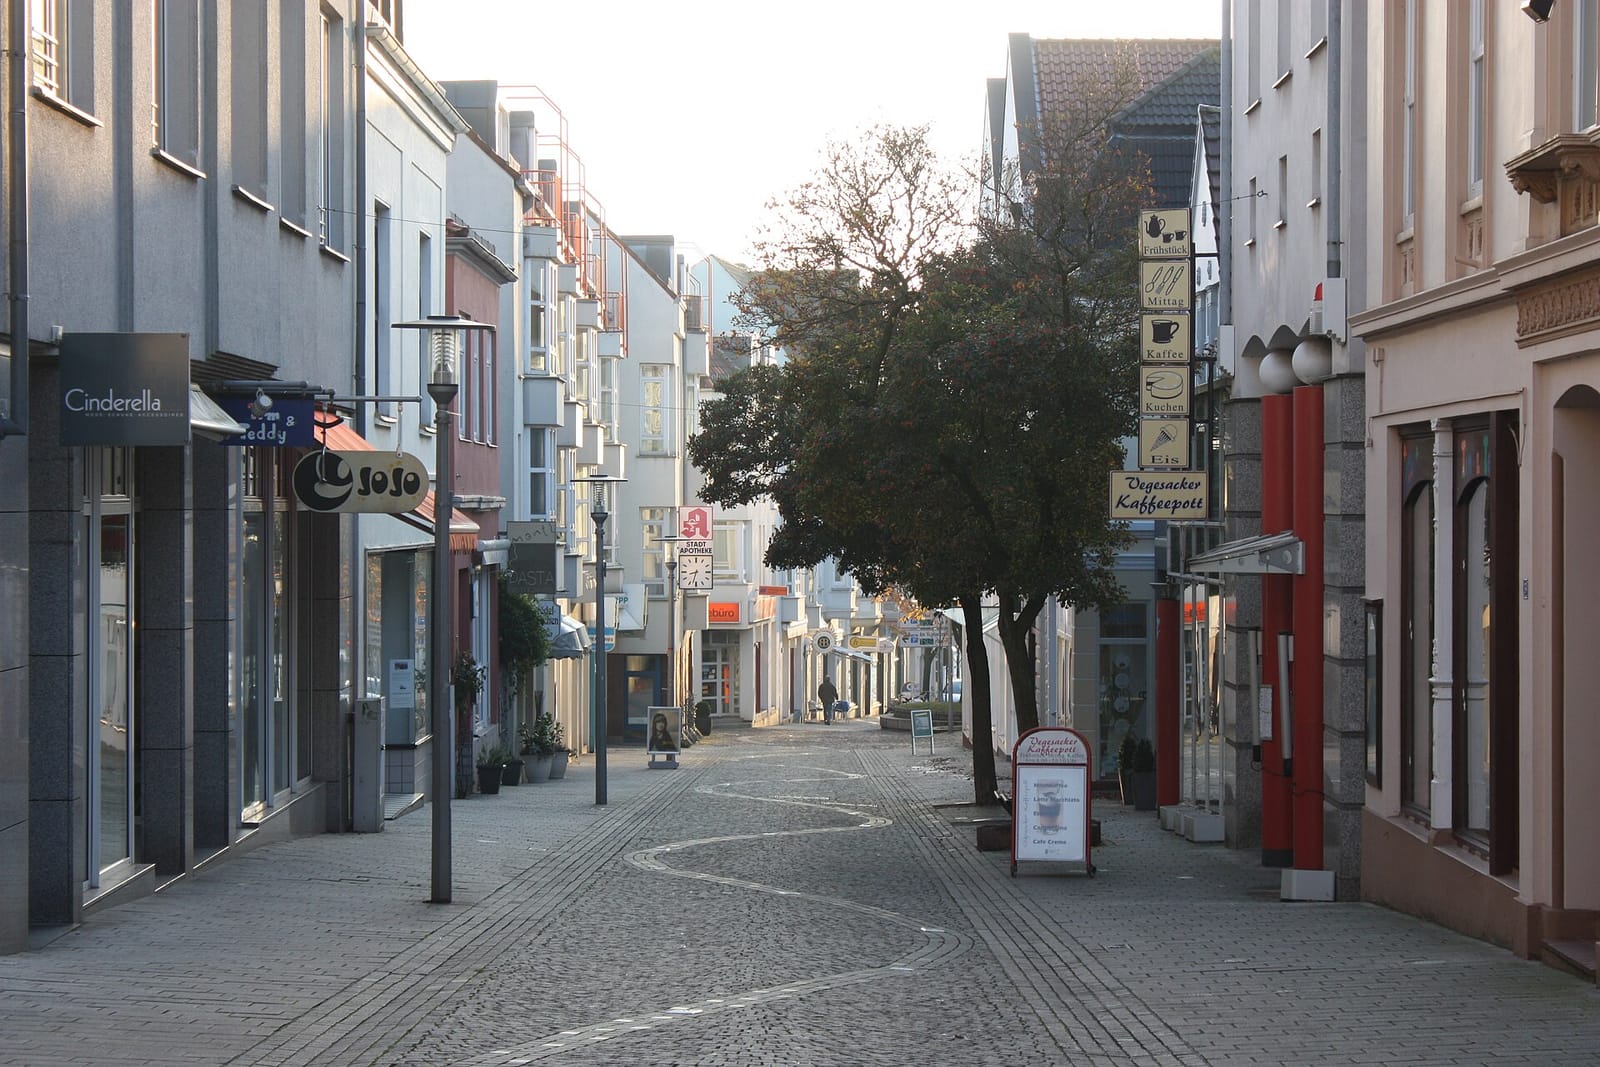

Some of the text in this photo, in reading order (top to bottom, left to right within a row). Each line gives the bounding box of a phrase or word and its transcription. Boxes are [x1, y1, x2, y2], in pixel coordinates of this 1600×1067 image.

[1144, 245, 1188, 255] Frühstück
[1147, 296, 1185, 306] Mittag
[1147, 349, 1184, 359] Kaffee
[64, 387, 161, 412] Cinderella
[1145, 402, 1184, 412] Kuchen
[286, 415, 296, 427] &
[1150, 455, 1180, 465] Eis
[1125, 476, 1201, 495] Vegesacker
[1115, 494, 1204, 515] Kaffeepott
